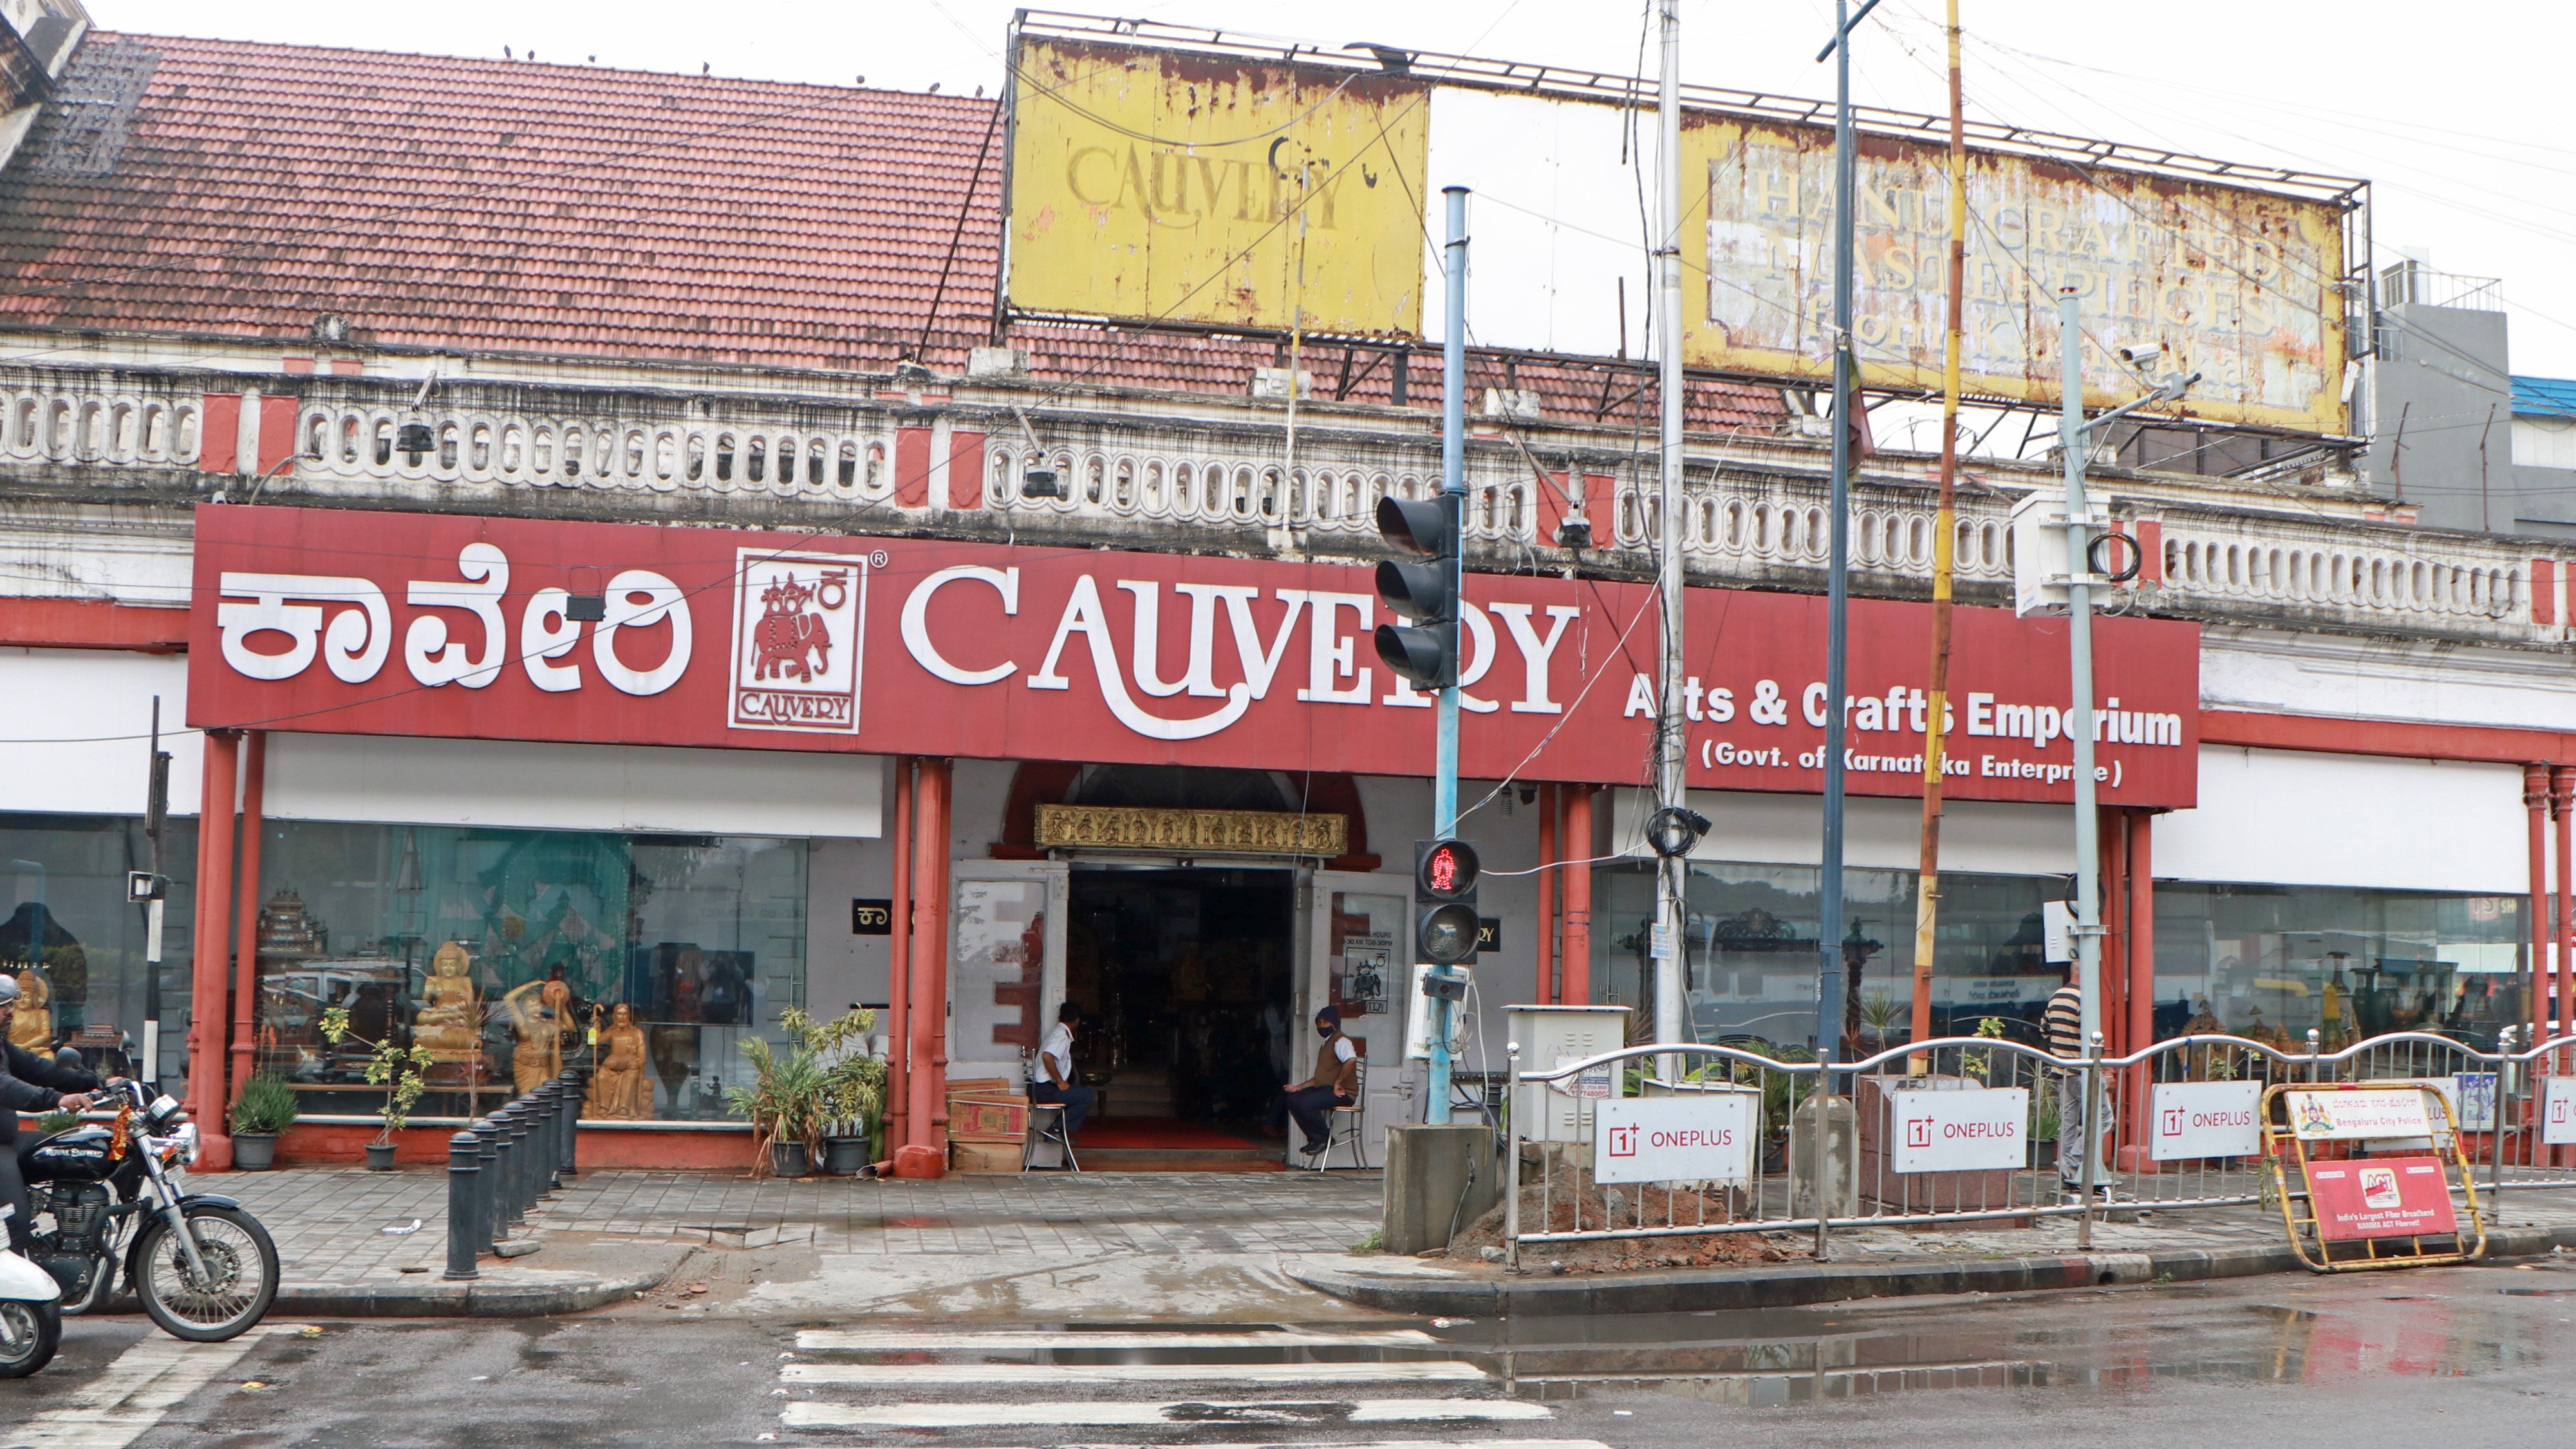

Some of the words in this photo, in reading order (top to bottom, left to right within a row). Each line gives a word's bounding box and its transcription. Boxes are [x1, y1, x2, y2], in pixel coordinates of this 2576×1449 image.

[1065, 142, 1346, 230] CAUVERY
[1804, 294, 1946, 353] fom
[217, 542, 693, 696] ಕಾವೇರಿ
[741, 693, 850, 724] CAUVERY
[1623, 673, 1735, 722] Ats
[1750, 679, 1787, 725] &
[1967, 691, 2181, 747] Emporium
[1702, 739, 1789, 769] (Govt.
[1981, 754, 2122, 788] Enterpre)
[1944, 1122, 2014, 1138] ONEPLUS
[2193, 1111, 2250, 1127] ONEPLUS
[2337, 1118, 2378, 1127] Bengaluru
[2381, 1117, 2396, 1126] City
[2398, 1117, 2422, 1125] Police
[1651, 1129, 1732, 1147] ONEPLUS
[2367, 1174, 2393, 1192] ACT
[2337, 1213, 2358, 1222] India's
[2359, 1211, 2384, 1222] Largest
[2385, 1211, 2400, 1219] Fiber
[2402, 1209, 2434, 1218] Broadband
